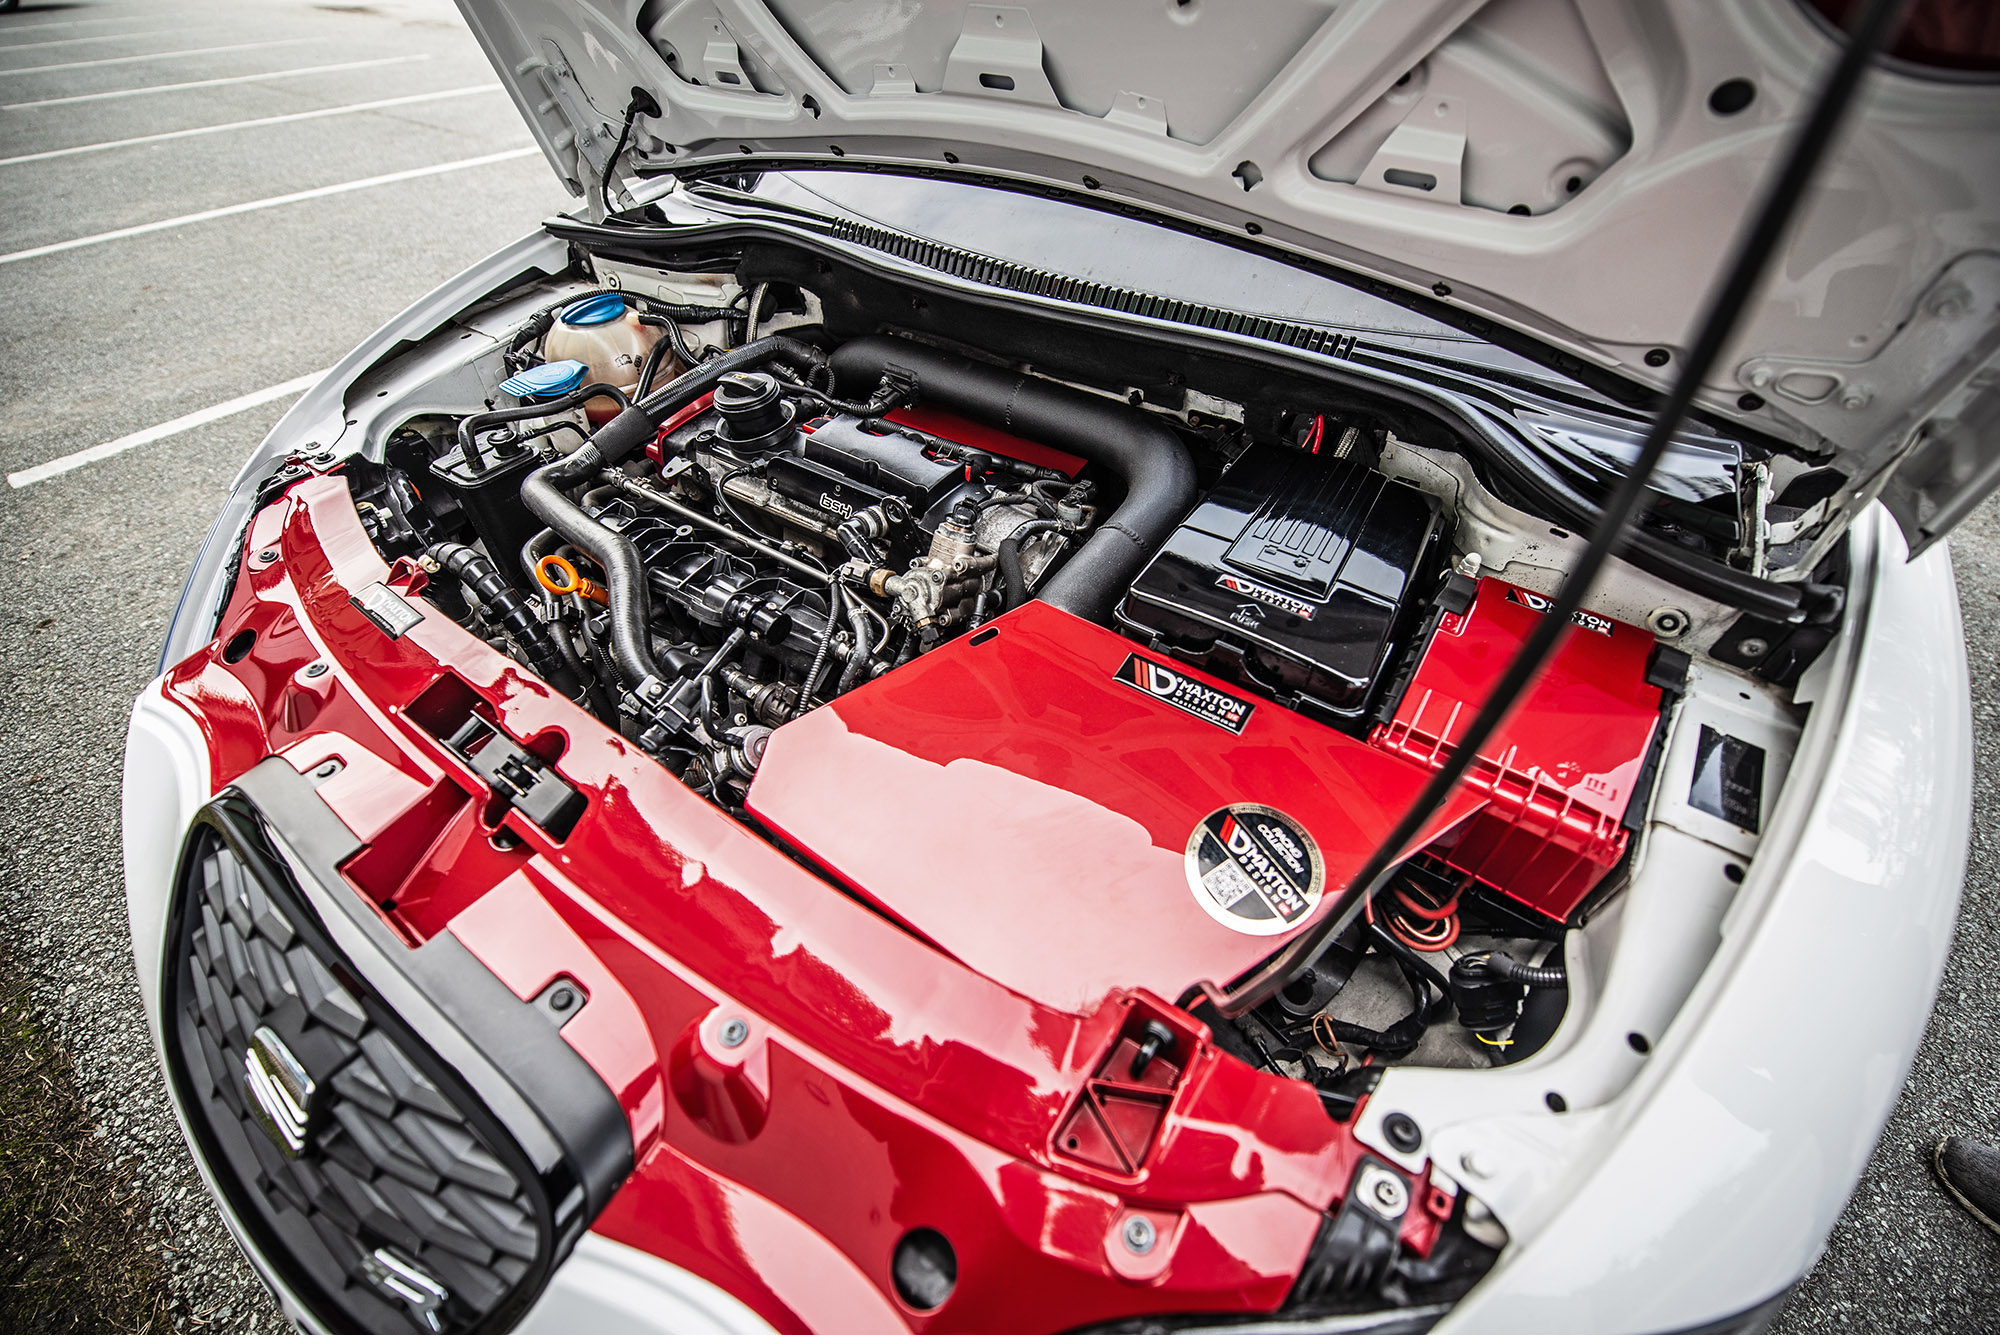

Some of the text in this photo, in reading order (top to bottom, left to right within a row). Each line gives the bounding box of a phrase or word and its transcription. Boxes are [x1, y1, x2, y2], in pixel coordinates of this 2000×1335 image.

[1251, 592, 1298, 613] DESIGN
[1254, 585, 1316, 613] MAXTON
[1174, 690, 1241, 722] DESIGN UK
[1178, 681, 1247, 716] MAXTON
[1257, 823, 1305, 874] COLLECTION
[1238, 854, 1282, 904] DESIGN
[1246, 847, 1304, 912] MAXTON
